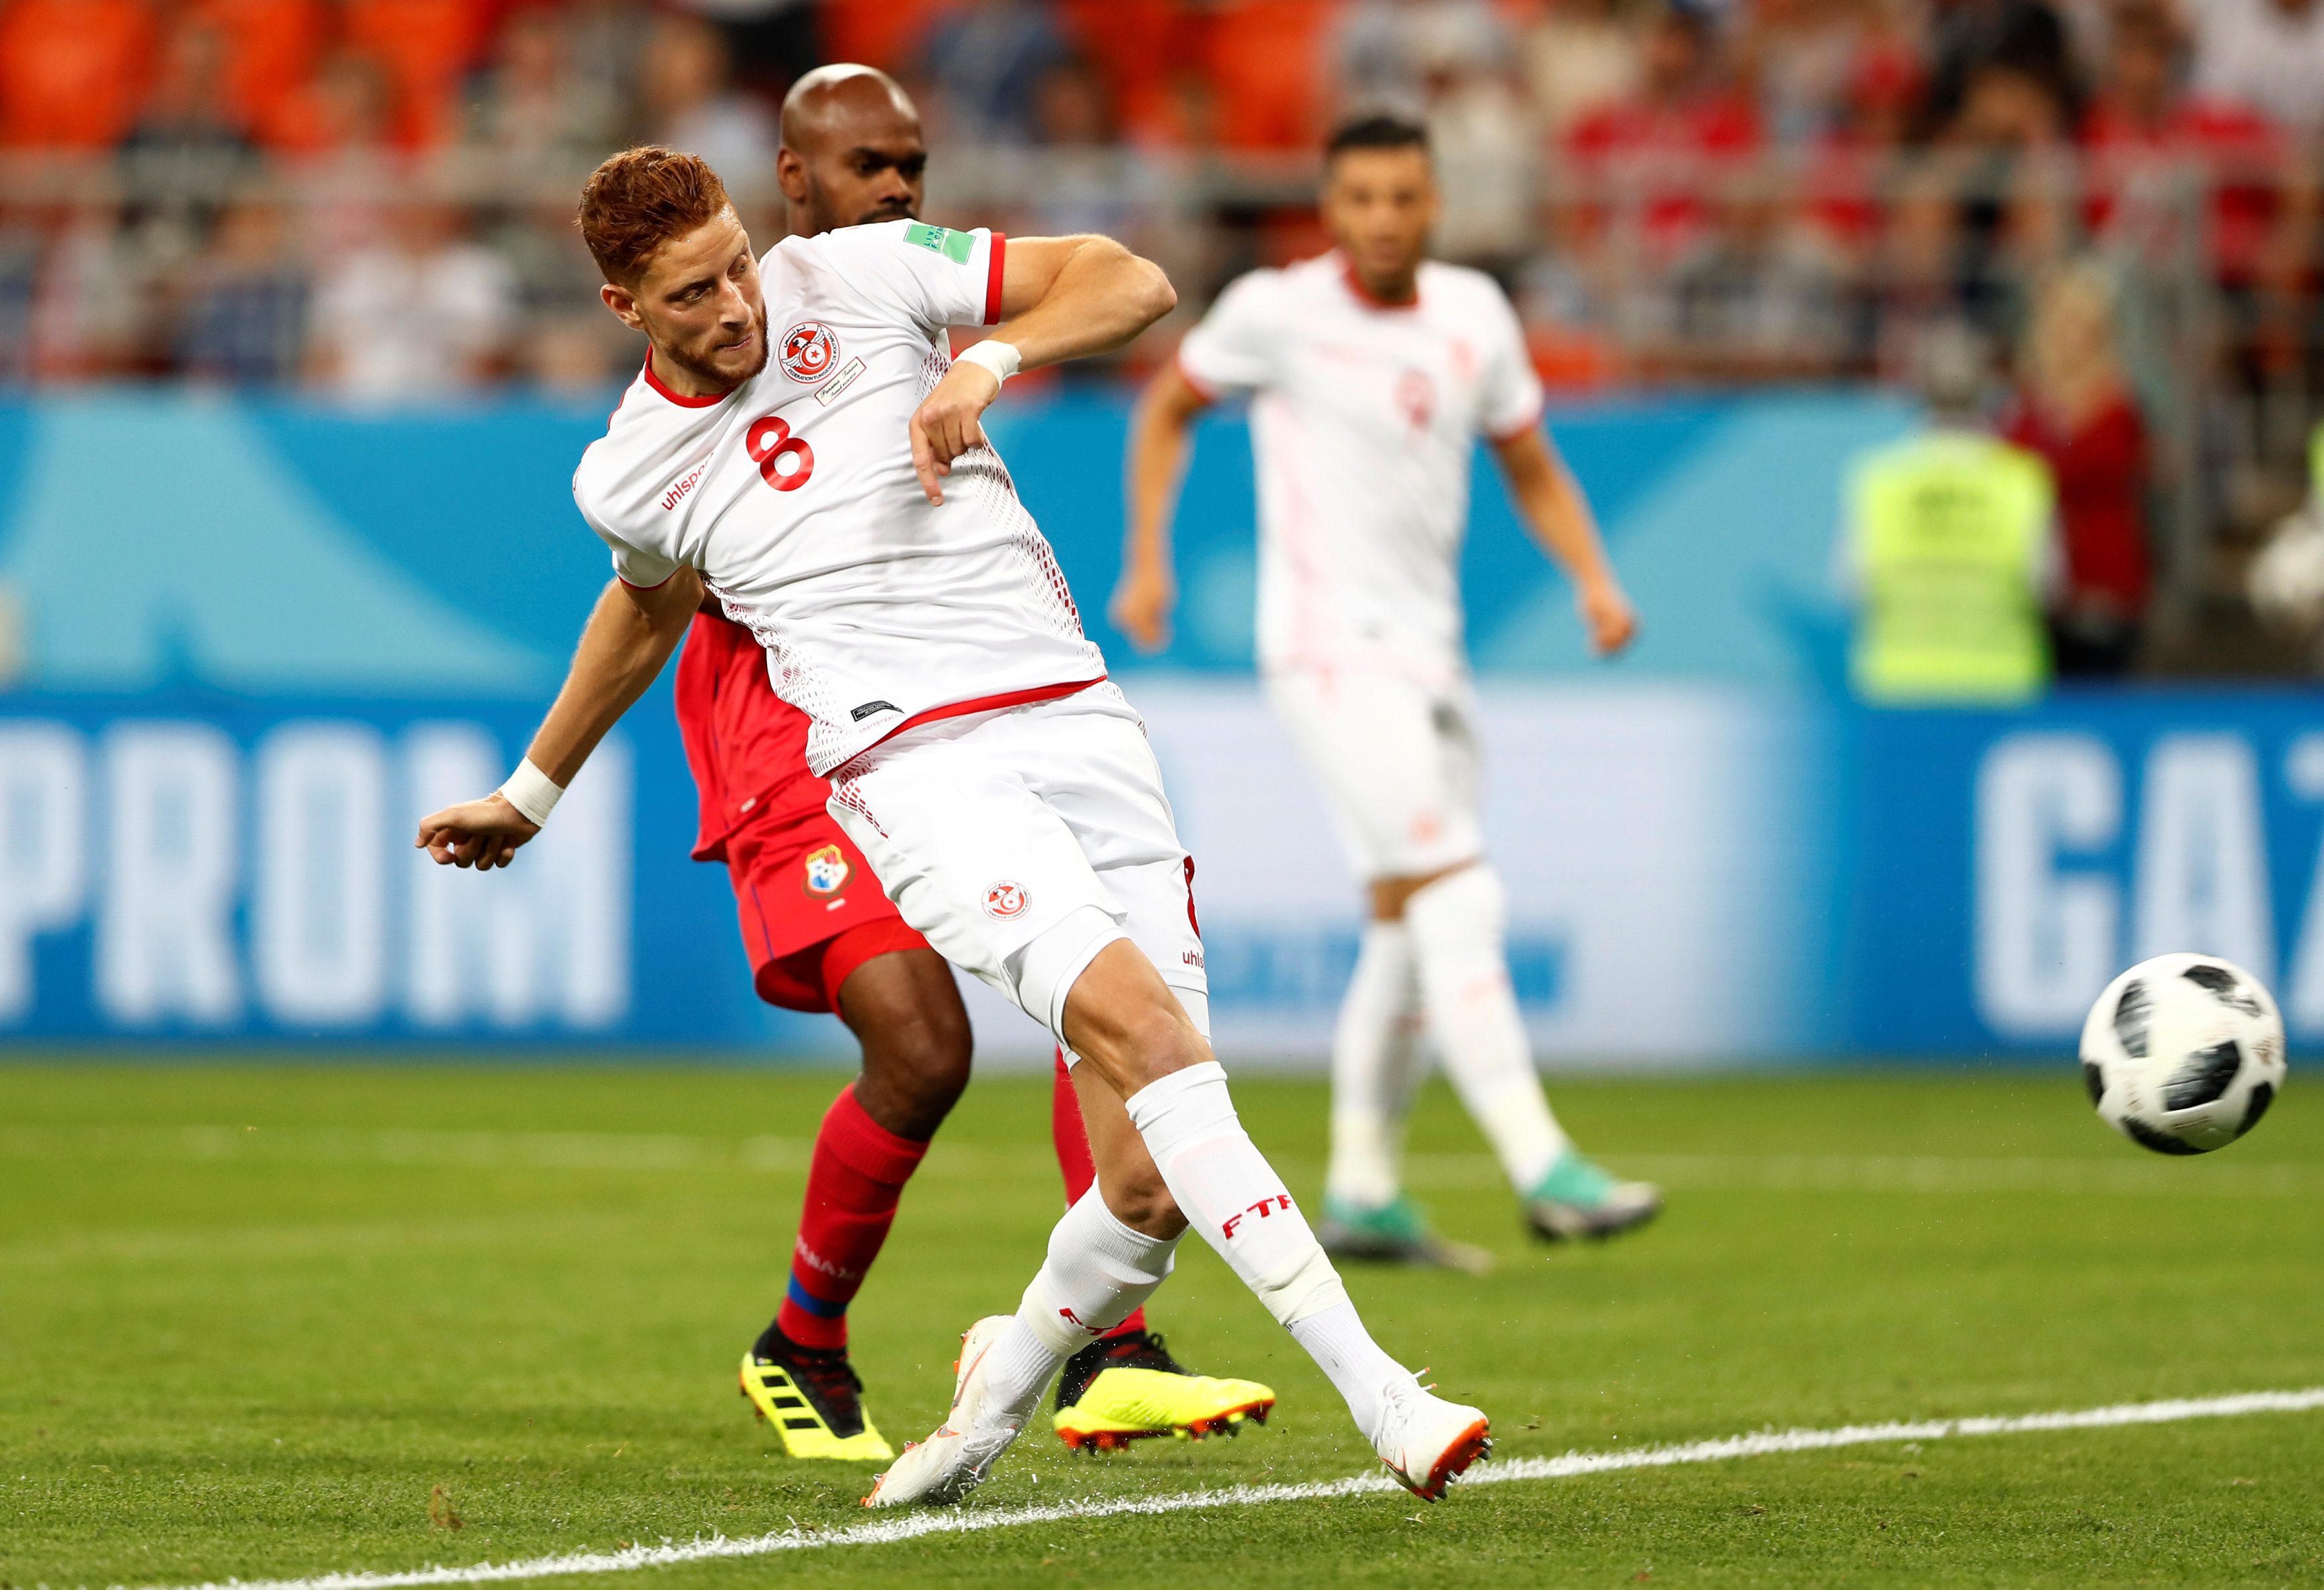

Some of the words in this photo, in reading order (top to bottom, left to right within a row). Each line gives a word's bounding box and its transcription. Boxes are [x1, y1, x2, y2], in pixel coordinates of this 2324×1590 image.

[788, 368, 813, 380] FEDERATION
[661, 452, 714, 511] uhlspo
[746, 416, 814, 491] 8
[0, 722, 629, 1022] PROM
